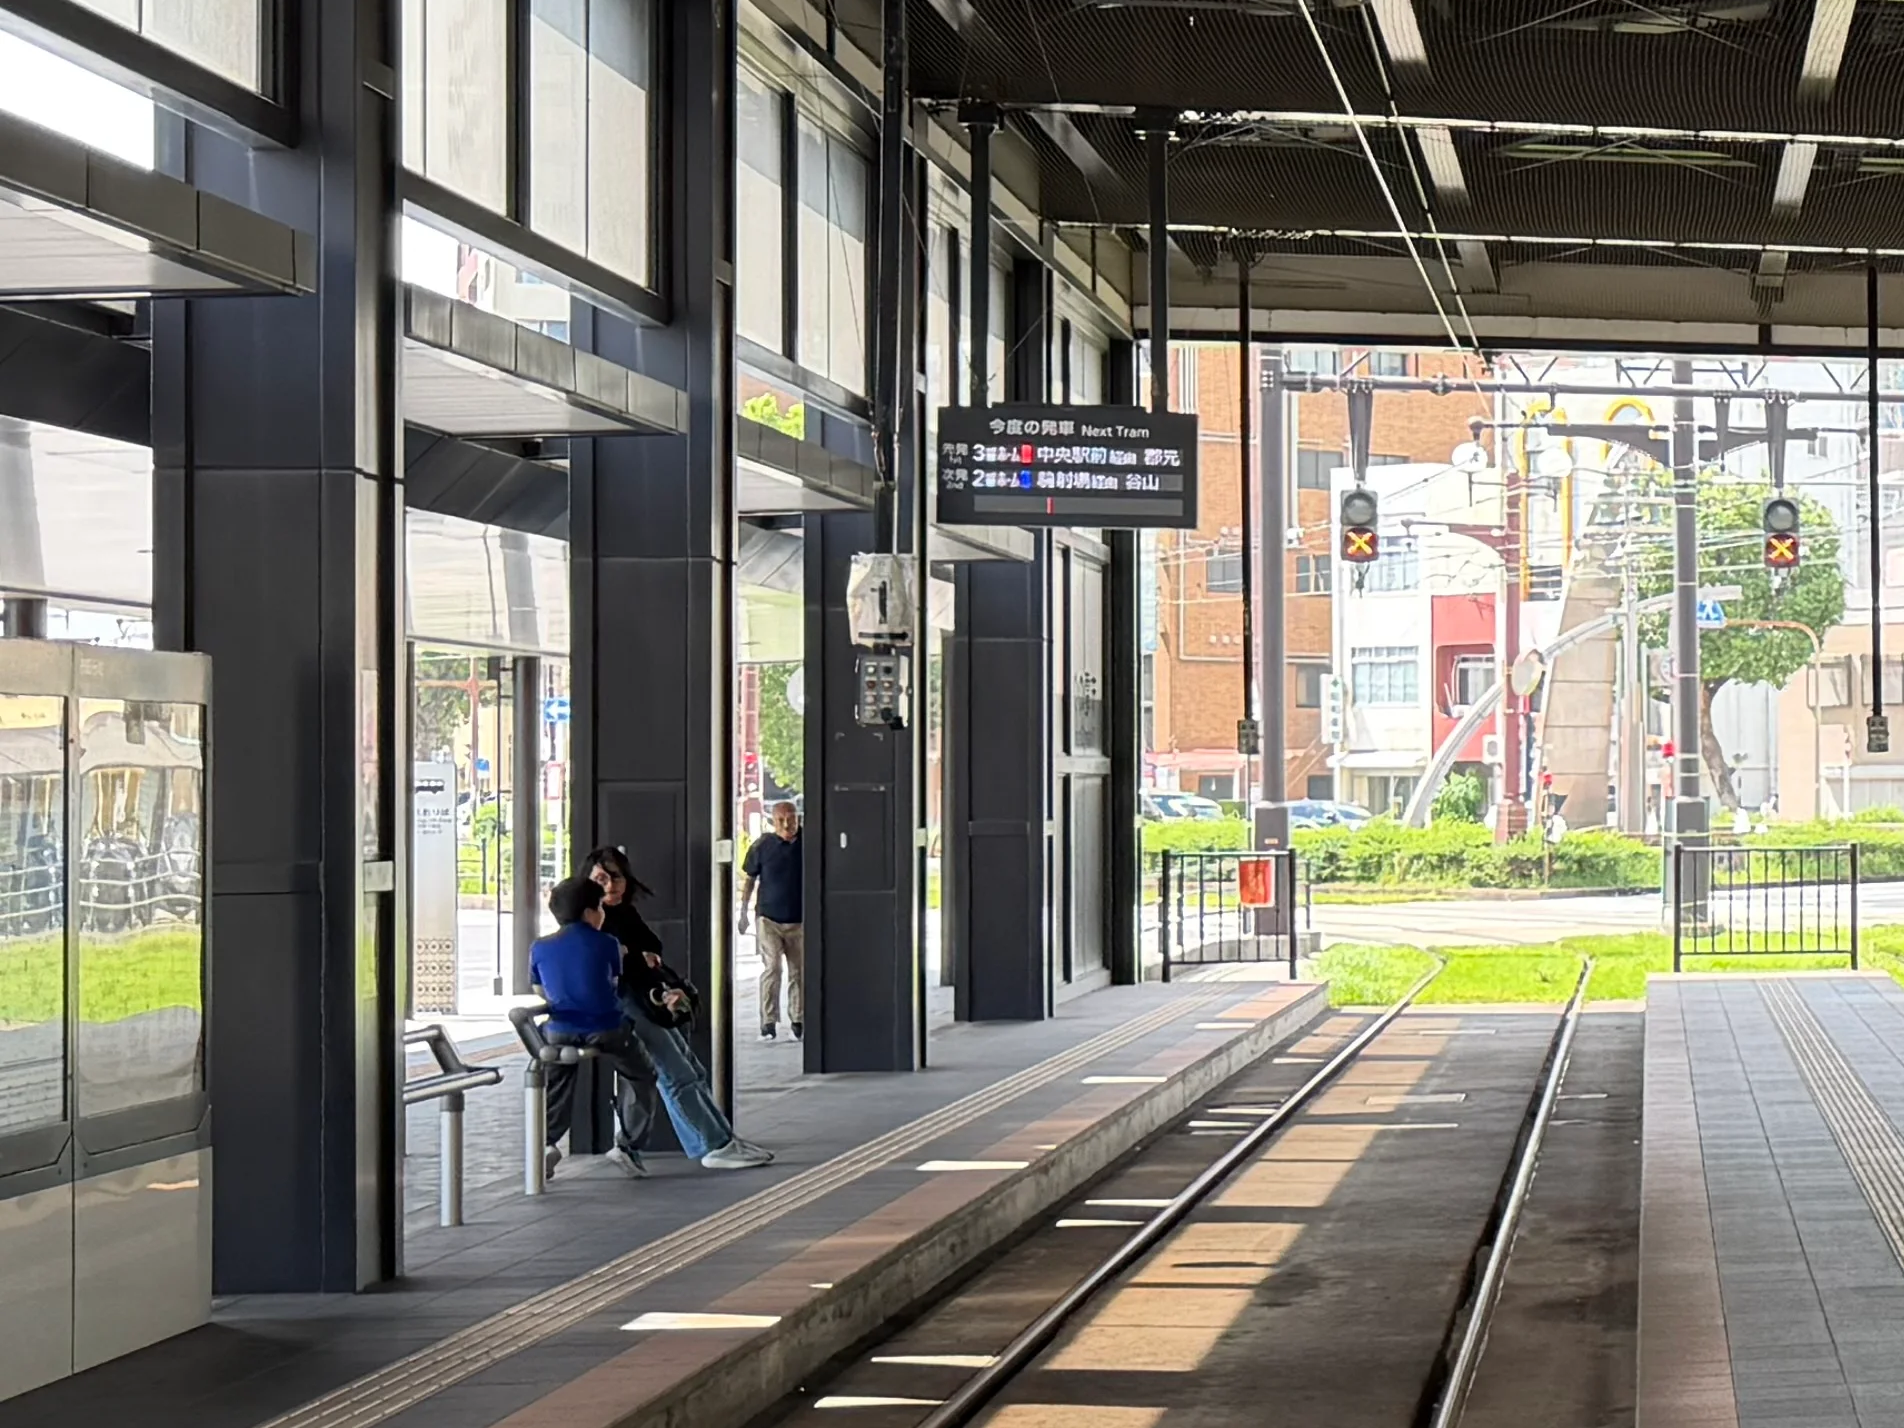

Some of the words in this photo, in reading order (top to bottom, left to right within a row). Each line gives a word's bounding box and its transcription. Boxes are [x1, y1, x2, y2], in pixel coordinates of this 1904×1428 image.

[989, 418, 1075, 436] 今度の発車
[1081, 424, 1112, 437] Next
[1116, 425, 1150, 439] Tram
[1125, 473, 1160, 492] 谷山
